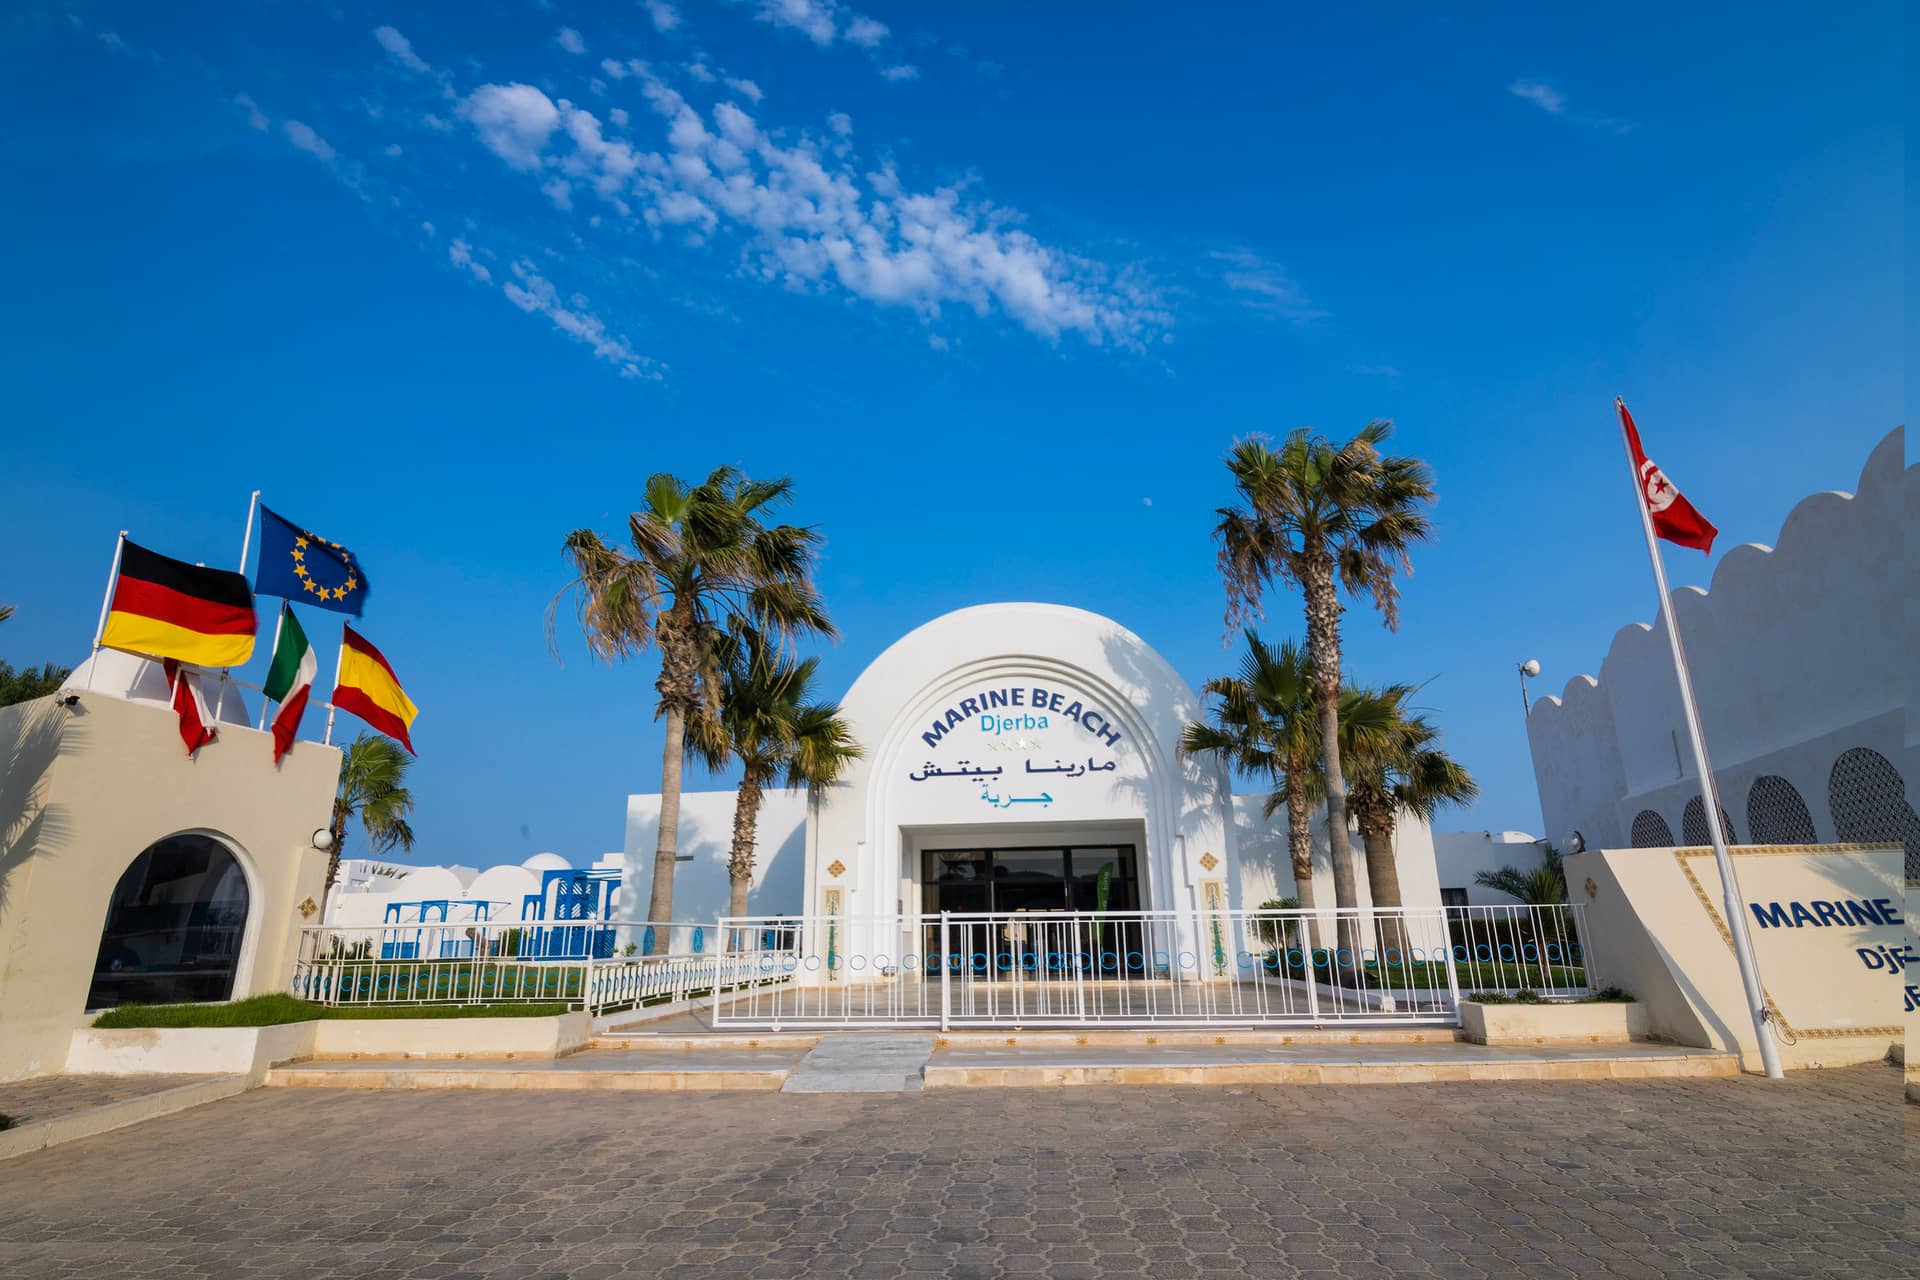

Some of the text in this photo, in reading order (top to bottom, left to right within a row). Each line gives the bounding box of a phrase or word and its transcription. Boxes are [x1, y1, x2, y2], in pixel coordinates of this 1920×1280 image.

[921, 688, 1121, 749] MARINE BEACH
[980, 713, 1049, 736] Djerba
[909, 757, 1116, 782] مارينا بيتش
[980, 784, 1053, 808] جربة
[1749, 899, 1905, 929] MARINE
